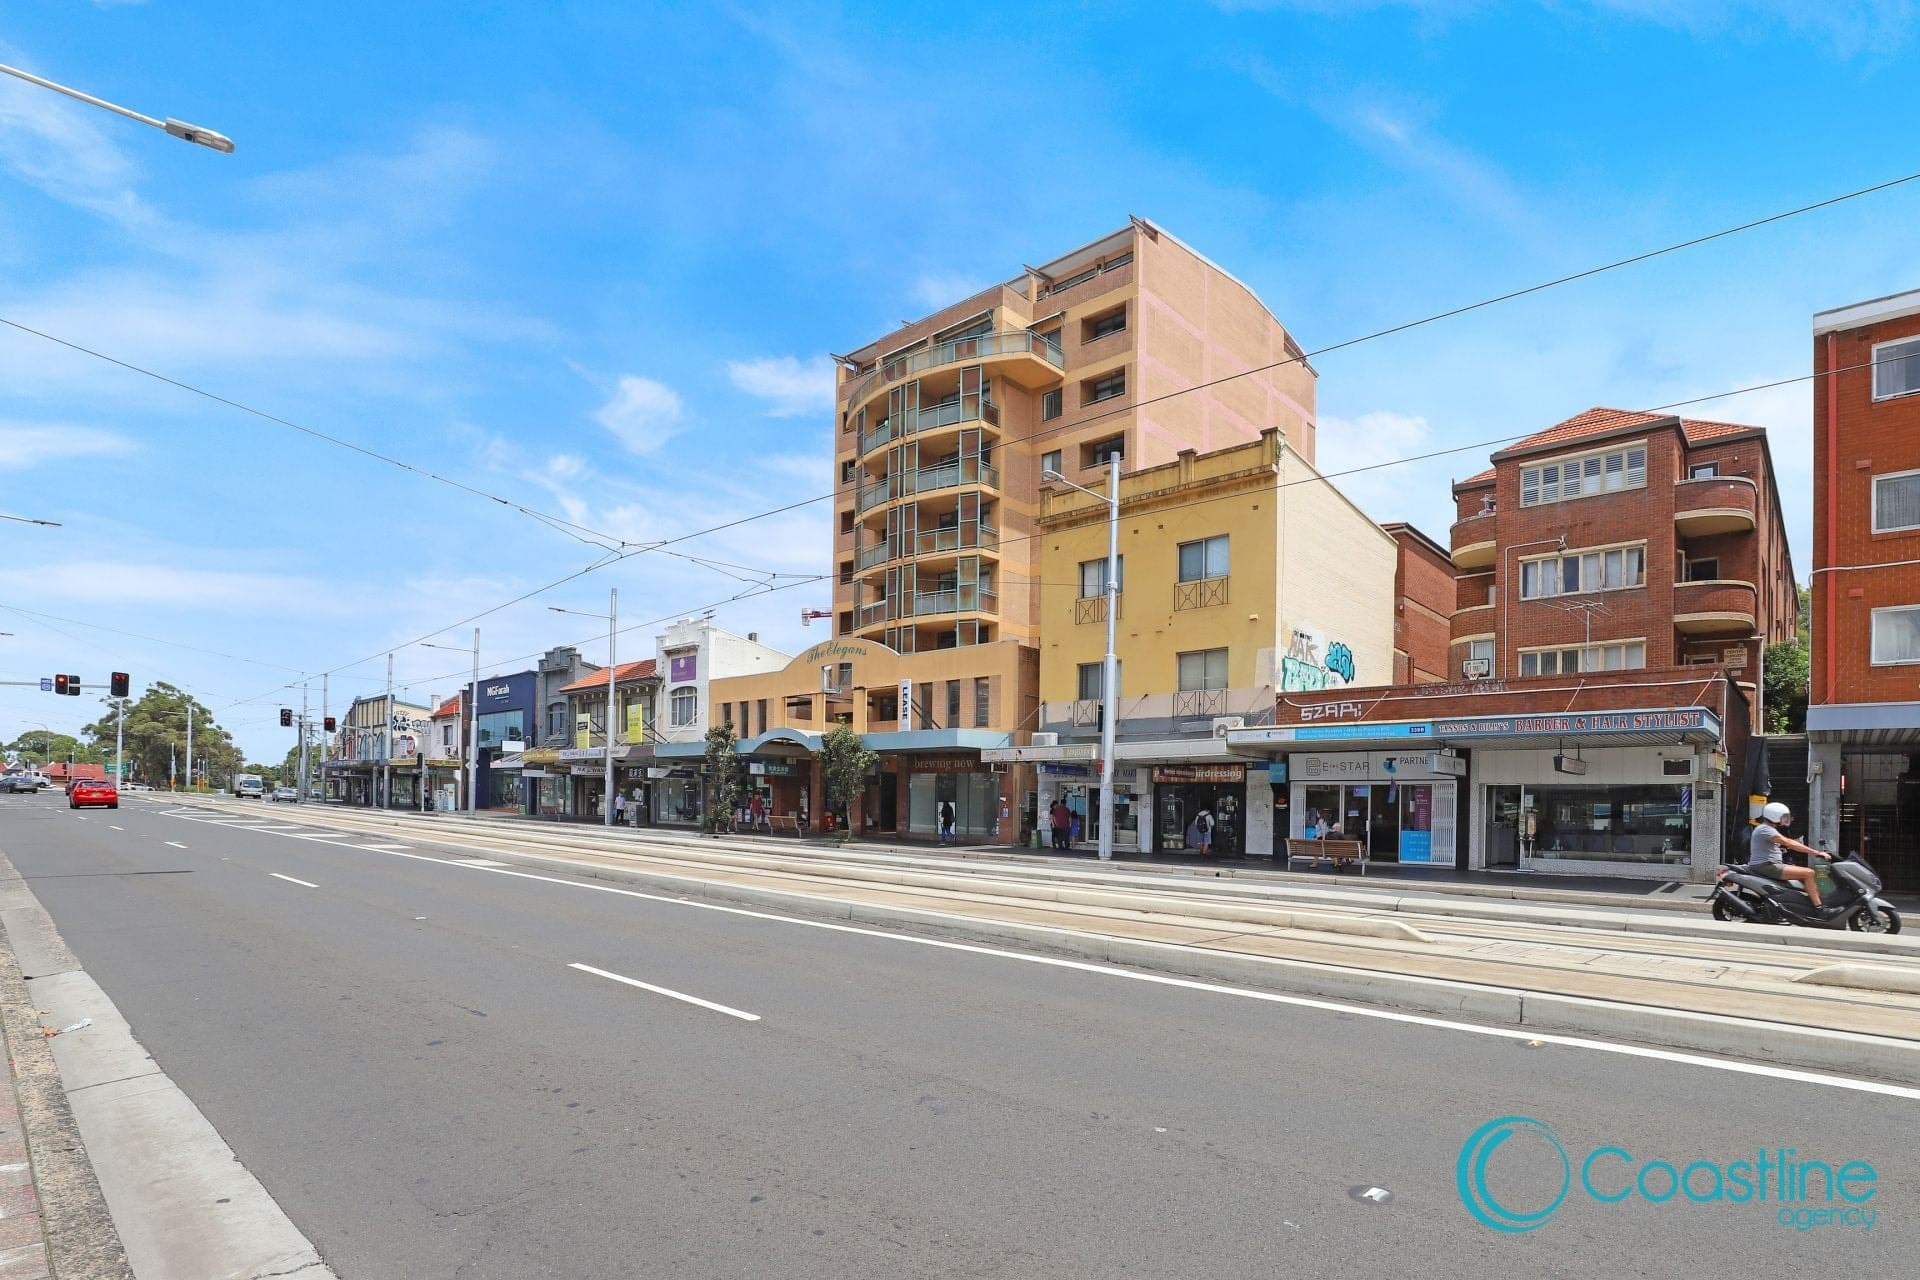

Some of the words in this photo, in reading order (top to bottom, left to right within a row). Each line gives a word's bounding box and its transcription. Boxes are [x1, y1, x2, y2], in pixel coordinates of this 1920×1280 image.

[807, 648, 825, 664] The
[901, 687, 909, 720] LEASE
[1515, 719, 1569, 733] BARBER
[1574, 717, 1586, 730] &
[1590, 715, 1629, 731] HAIR
[1634, 712, 1702, 729] STYLIST
[913, 759, 952, 770] brewing
[954, 759, 976, 768] now
[1399, 756, 1431, 765] PARTNE
